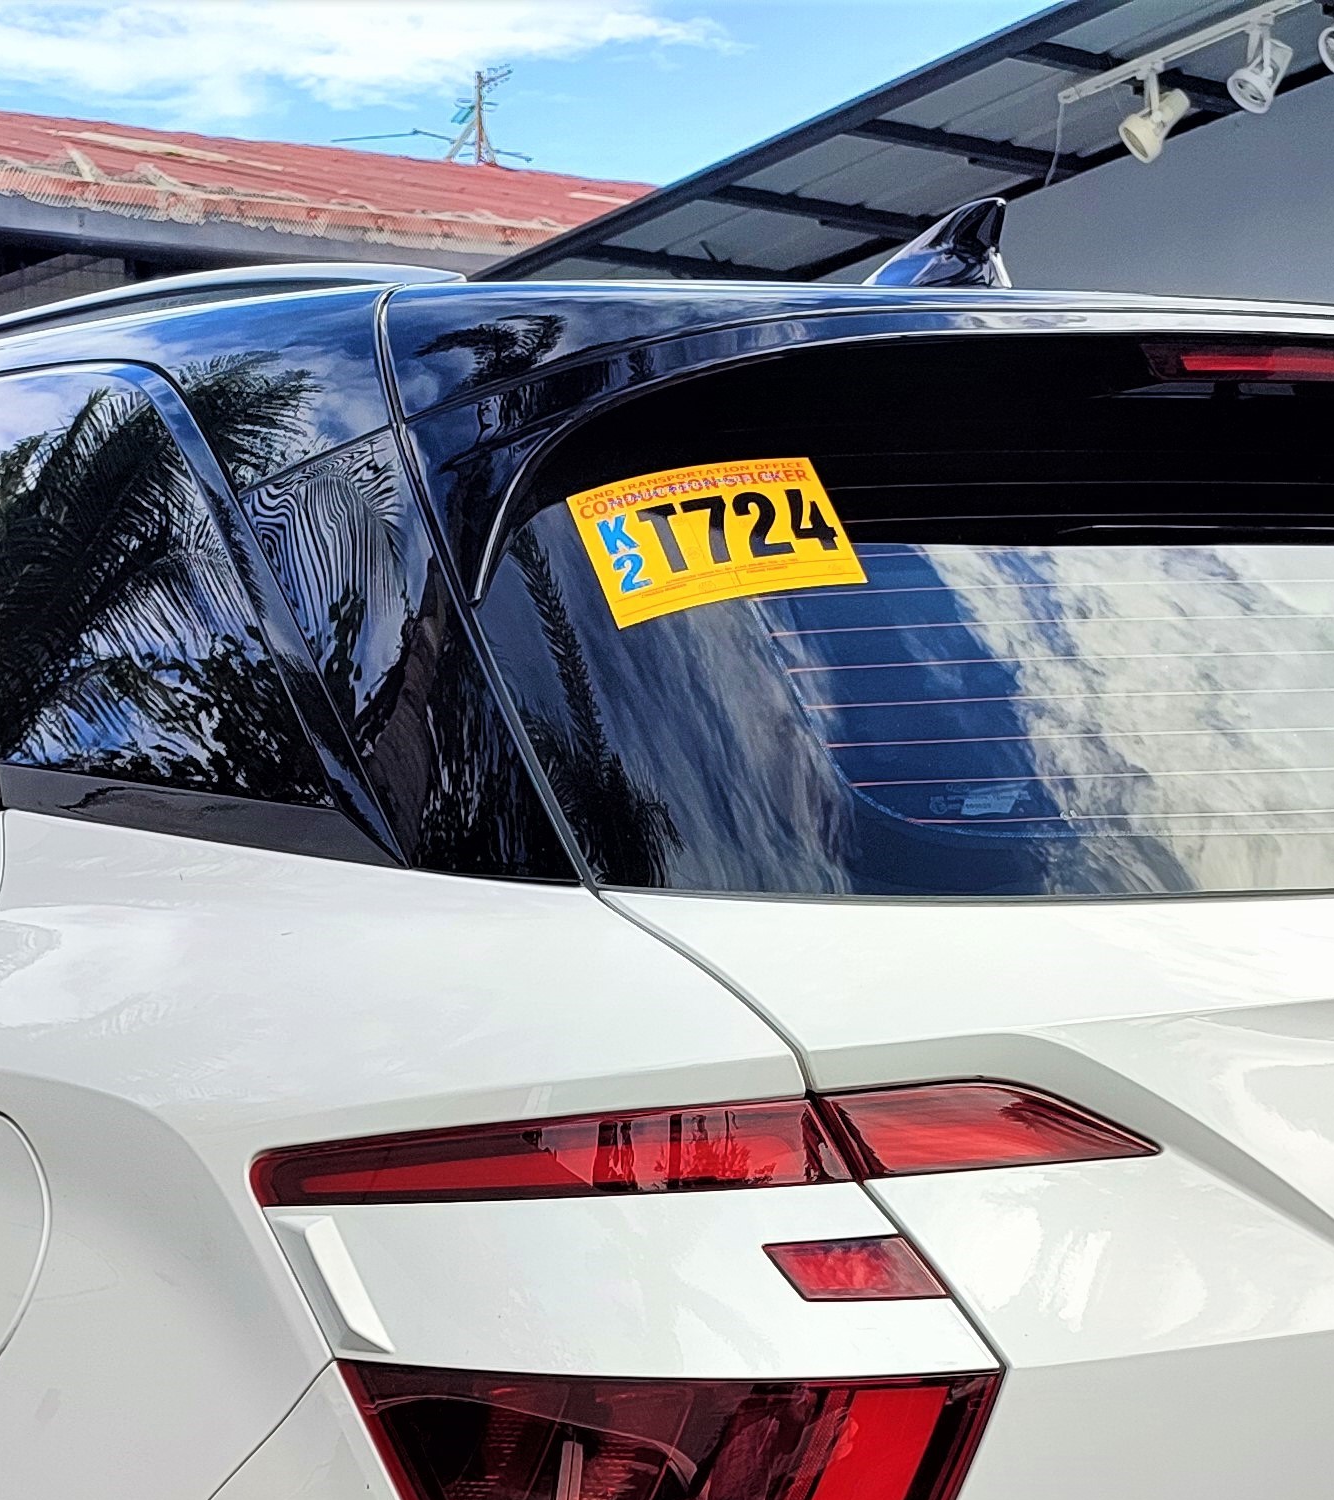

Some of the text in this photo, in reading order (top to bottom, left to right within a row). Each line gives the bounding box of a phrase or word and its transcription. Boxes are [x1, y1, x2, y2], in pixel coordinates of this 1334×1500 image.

[576, 489, 615, 506] LAND
[620, 465, 750, 493] TRANSPORTATION
[754, 461, 805, 471] OFFICE
[579, 477, 718, 520] CONDUCTION
[724, 469, 811, 488] STICKER
[636, 488, 838, 573] T724
